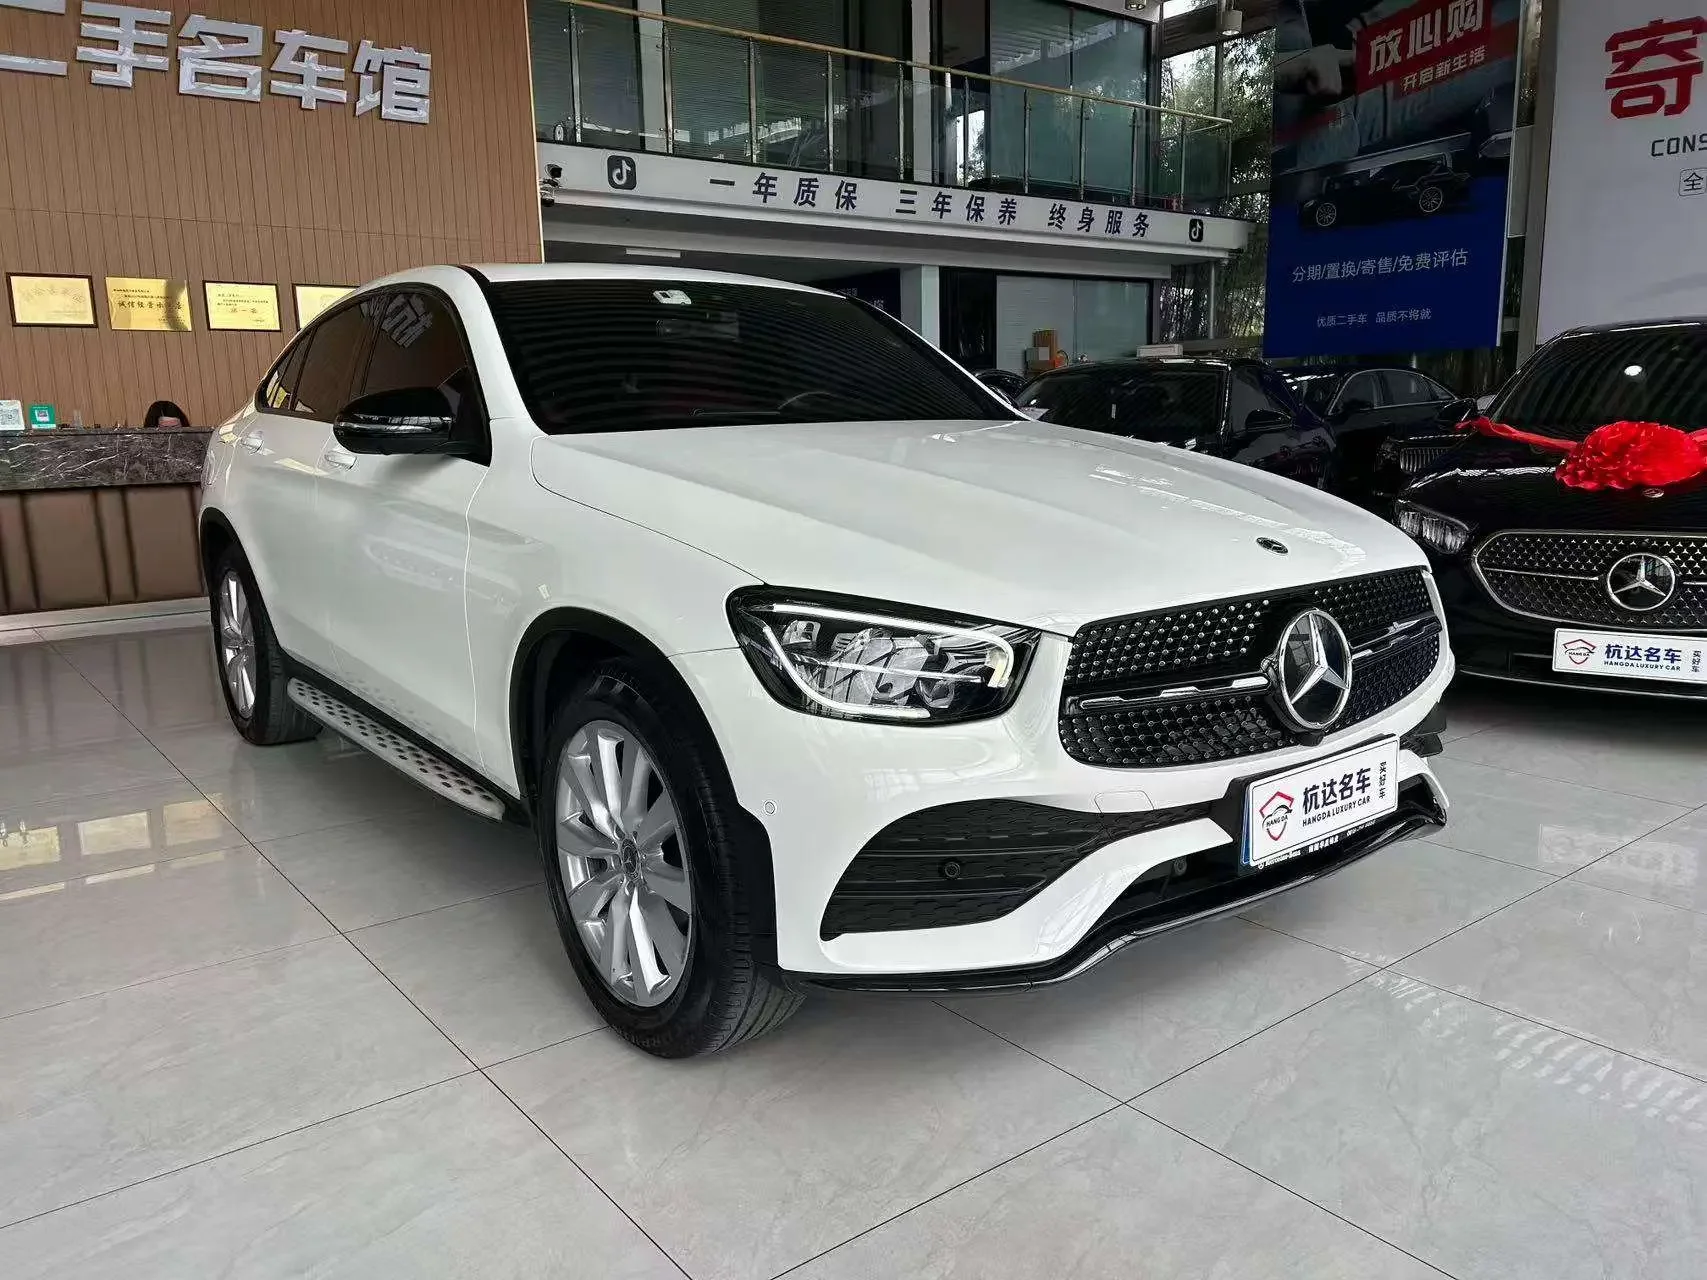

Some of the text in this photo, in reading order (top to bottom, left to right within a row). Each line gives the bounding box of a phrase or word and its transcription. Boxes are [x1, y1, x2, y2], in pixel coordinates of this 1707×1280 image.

[1368, 0, 1484, 76] 放心购
[0, 0, 432, 124] 二手名车馆
[1402, 44, 1487, 91] 开启新生活
[1605, 16, 1707, 119] 寄
[709, 172, 1151, 237] 一年质保 三年保养 终身服务
[1292, 248, 1469, 283] 分期/置换/寄售/免费评估
[1317, 307, 1432, 328] 优质二手车 品质不将就
[1605, 644, 1682, 664] 杭达名车
[1636, 662, 1664, 670] LUXURY
[1302, 767, 1371, 815] 杭达名车
[1302, 795, 1371, 827] HANGDA LUXURY CAR
